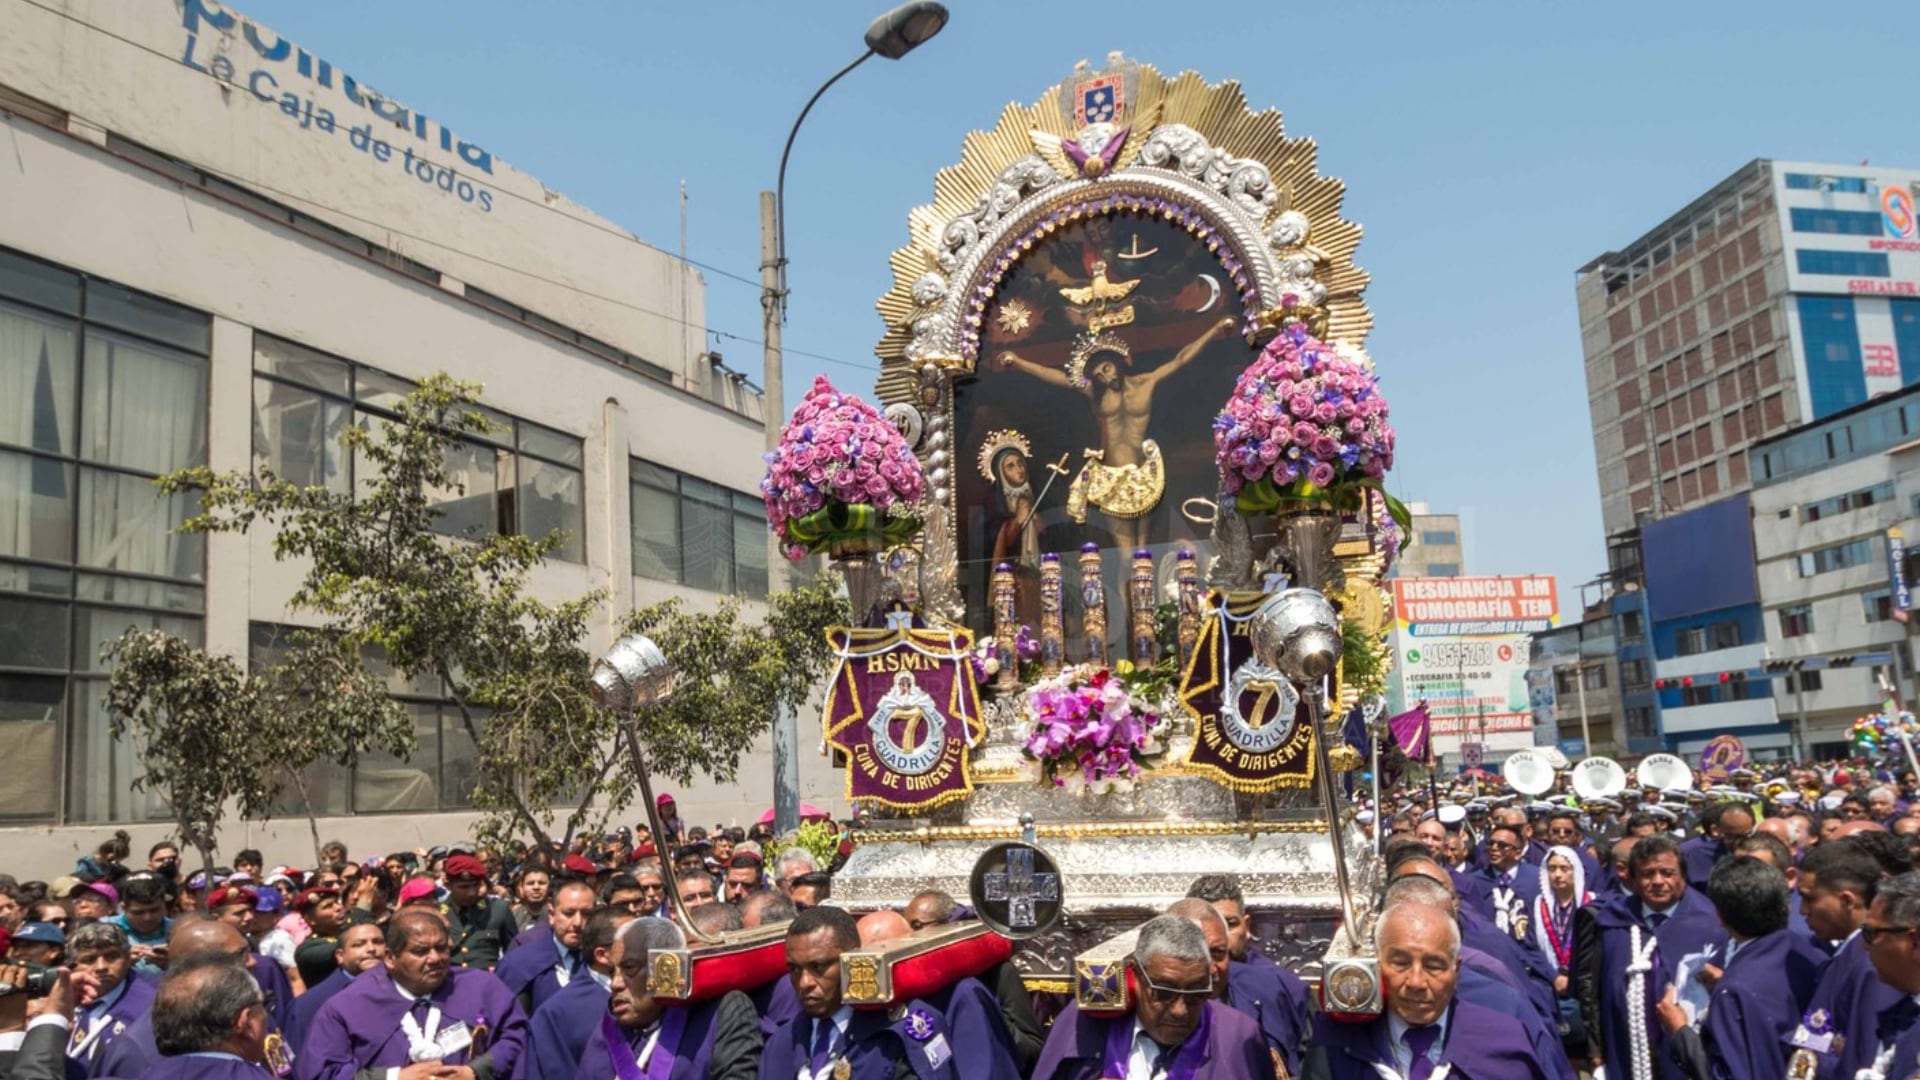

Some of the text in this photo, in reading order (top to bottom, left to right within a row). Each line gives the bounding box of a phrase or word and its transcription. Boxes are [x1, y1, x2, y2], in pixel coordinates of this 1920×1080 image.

[182, 33, 494, 213] La Caja de todos
[1403, 580, 1516, 599] RESONANCIA
[1404, 599, 1553, 620] TOMOGRAFÍA TEM
[866, 652, 941, 674] HSMN
[1245, 679, 1276, 729] 7
[891, 707, 923, 754] 7
[1202, 714, 1221, 751] CUNA
[1218, 744, 1238, 763] DE
[1239, 724, 1313, 771] DIRIGENTES
[1224, 714, 1291, 748] CUADRILLA
[854, 737, 961, 791] CUNA DE DIRIGENTES
[877, 737, 941, 769] CUADRILLA
